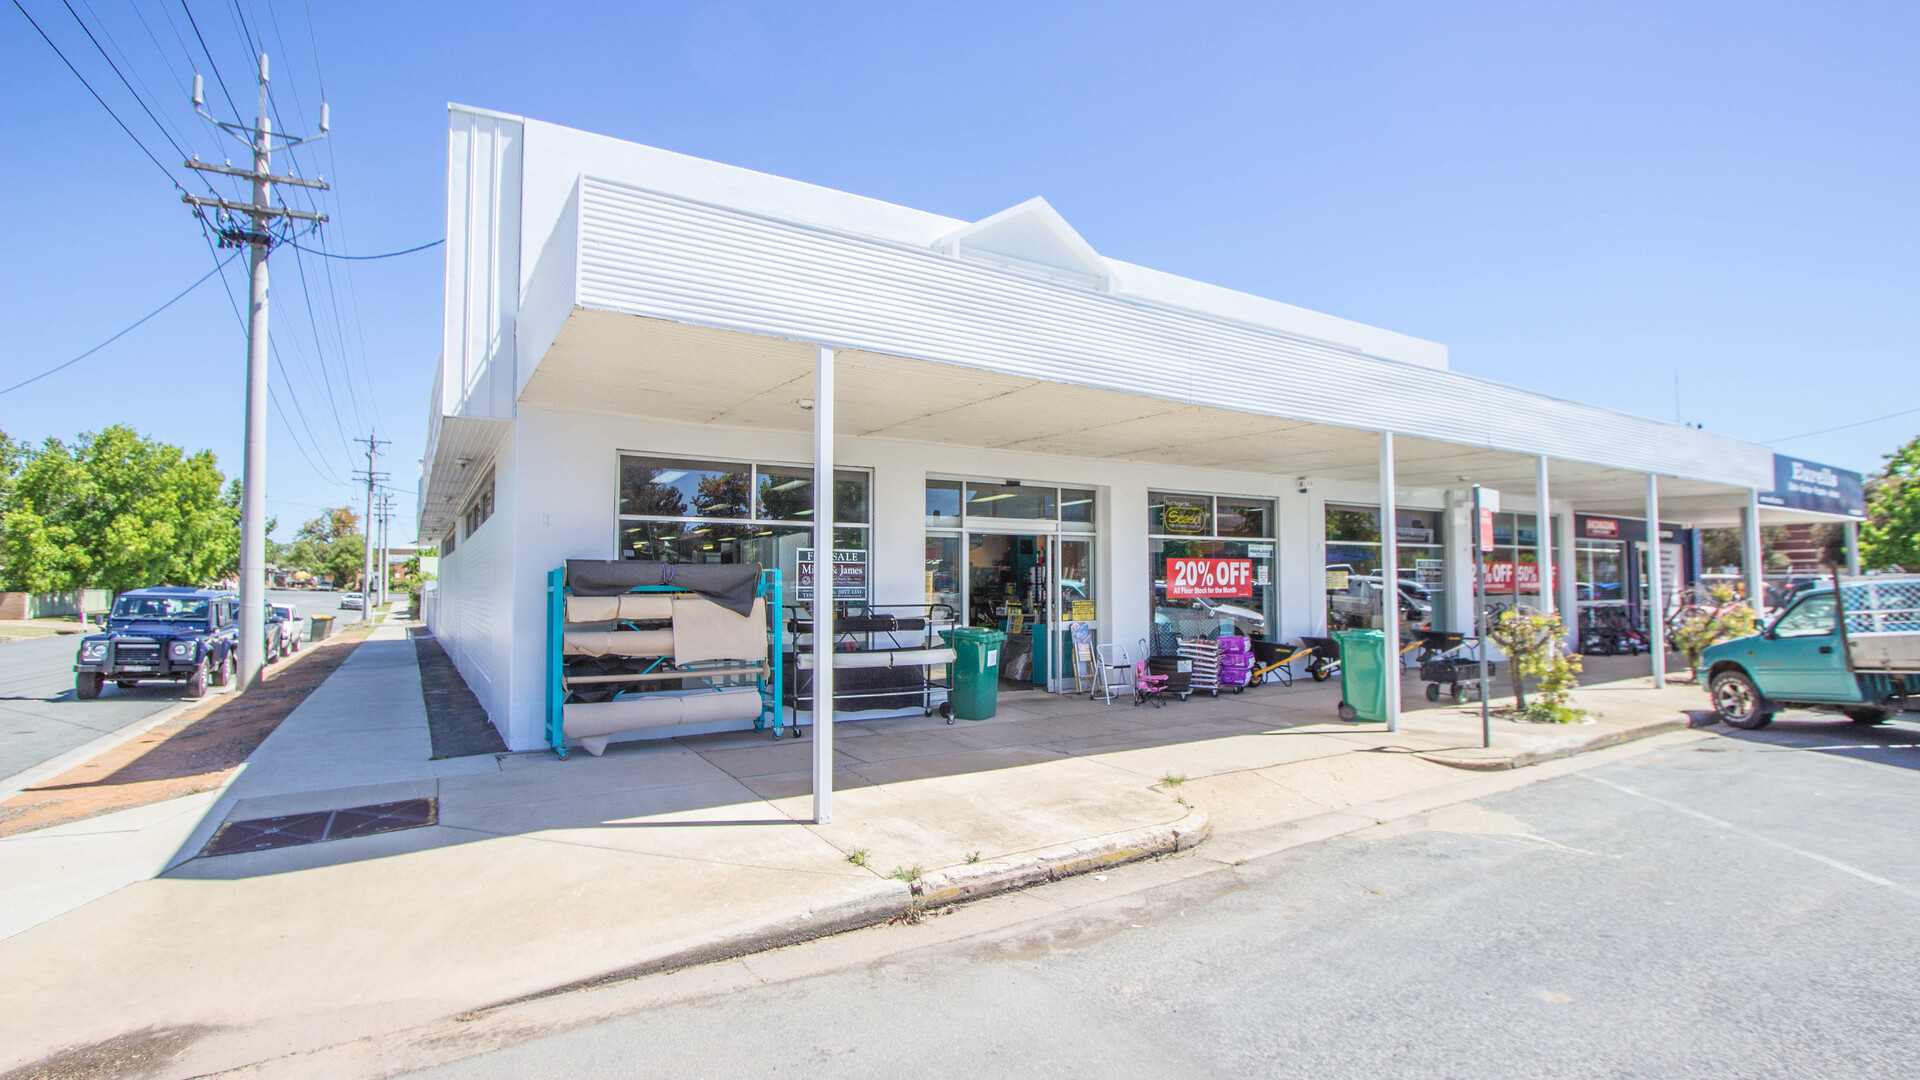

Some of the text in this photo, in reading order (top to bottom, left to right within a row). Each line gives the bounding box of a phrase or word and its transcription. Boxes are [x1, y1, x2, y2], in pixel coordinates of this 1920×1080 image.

[1587, 520, 1616, 530] HONDA
[832, 553, 859, 561] SALE
[839, 565, 863, 576] James
[1175, 561, 1214, 587] 20%
[1216, 561, 1250, 585] OFF
[1492, 564, 1513, 583] OFF
[1517, 565, 1538, 582] 50%
